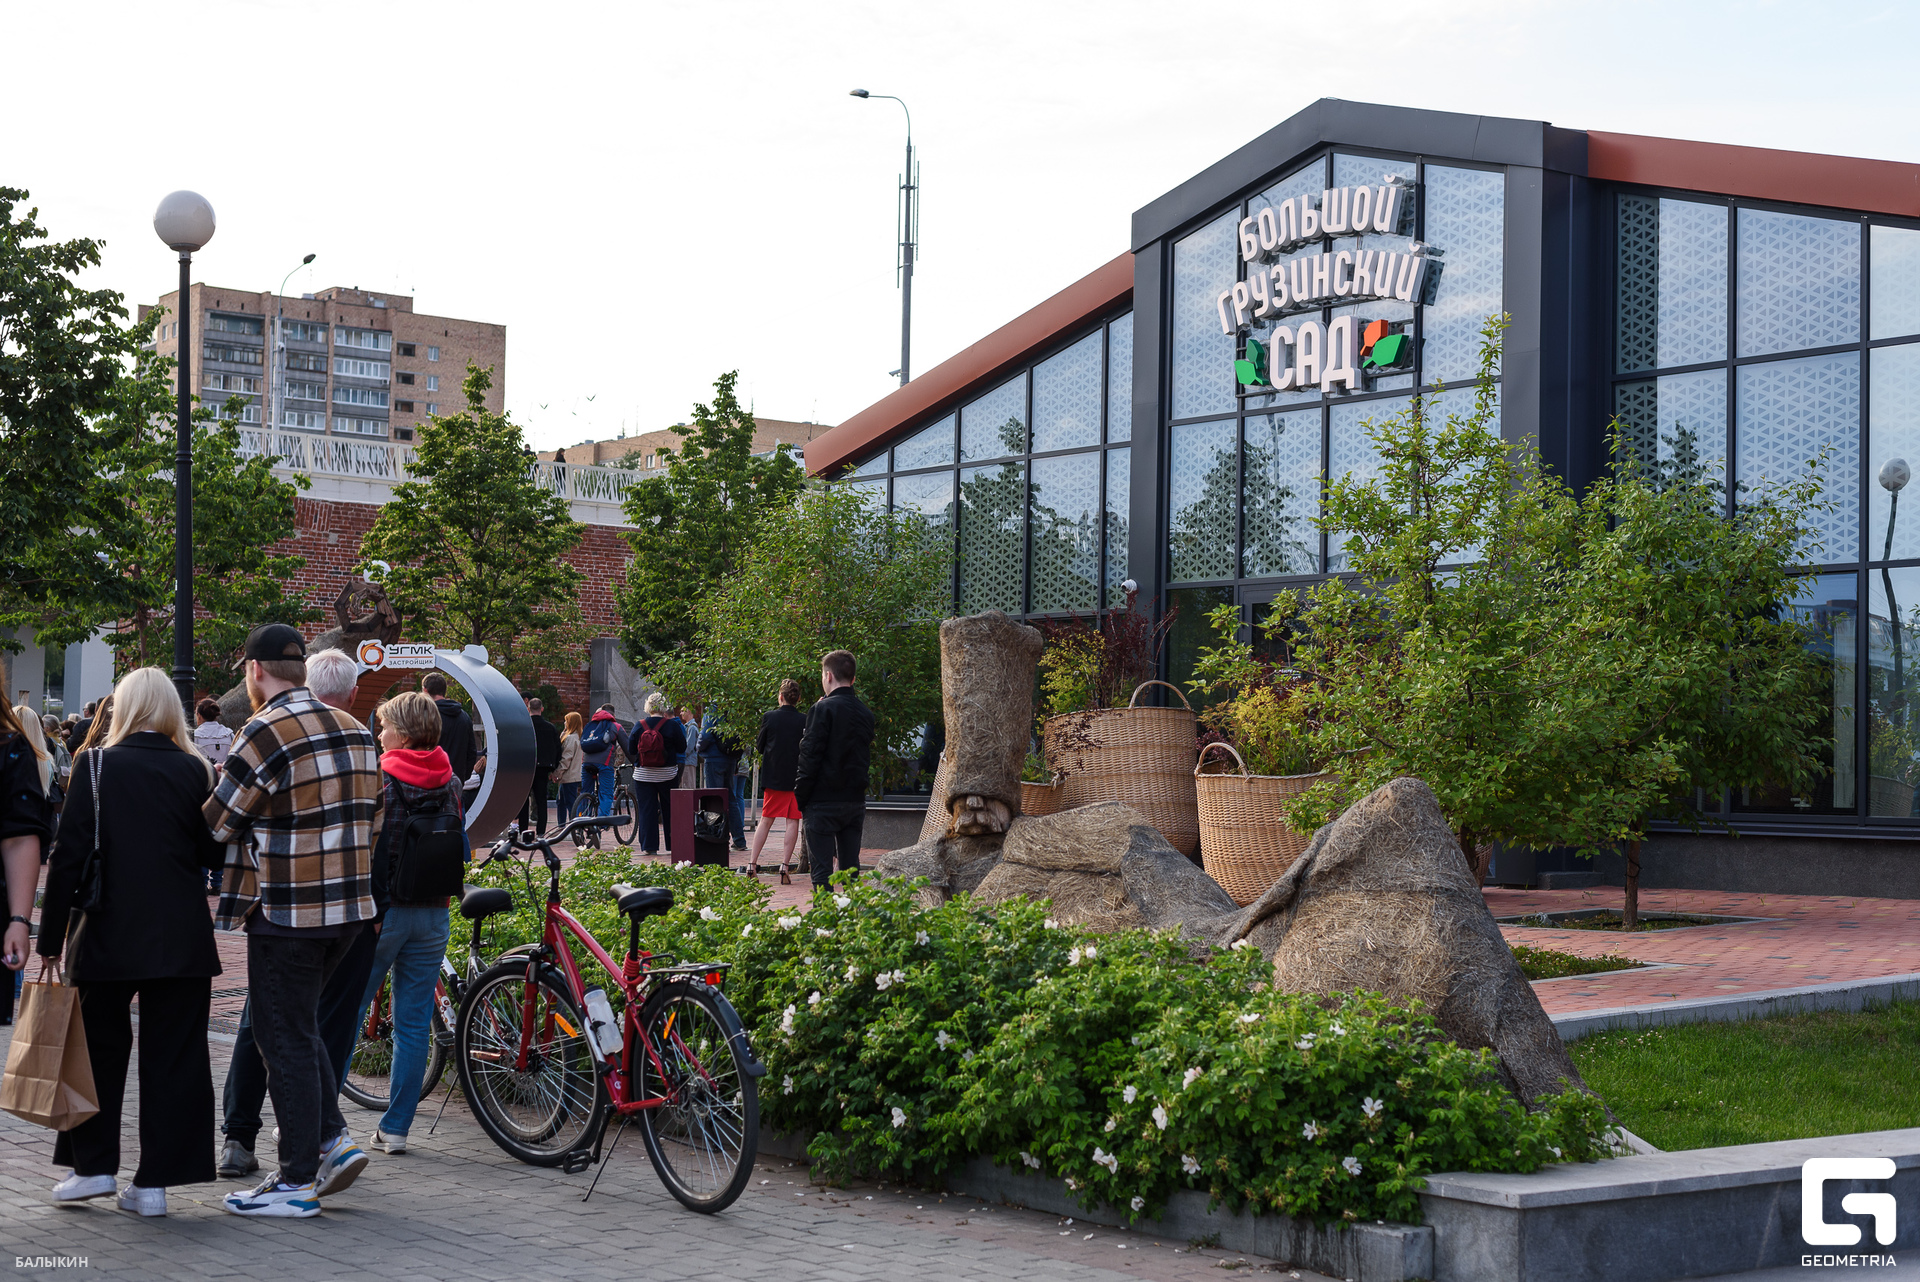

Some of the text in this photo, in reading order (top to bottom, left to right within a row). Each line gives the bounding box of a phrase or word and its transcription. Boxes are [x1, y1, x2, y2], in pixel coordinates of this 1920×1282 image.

[1239, 174, 1403, 261] БОЛЬШОЙ
[1217, 242, 1423, 335] ГРУЗИНСКИЙ
[1270, 315, 1358, 393] САД
[389, 646, 432, 655] УГМК
